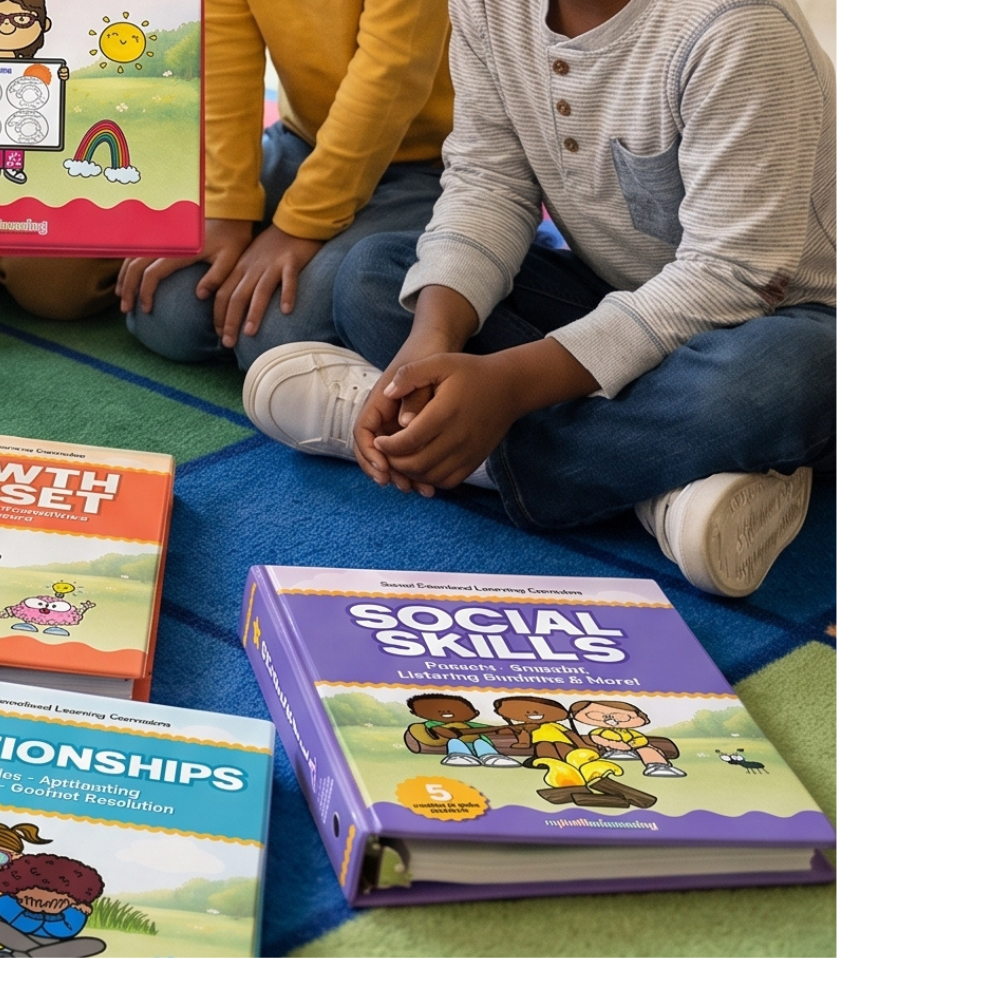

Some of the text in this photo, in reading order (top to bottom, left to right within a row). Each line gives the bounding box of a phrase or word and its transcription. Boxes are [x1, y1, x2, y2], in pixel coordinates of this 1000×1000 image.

[350, 603, 624, 637] SOCIAL
[375, 629, 626, 664] SKILLS
[85, 792, 175, 815] Resolution
[426, 783, 453, 802] 5
